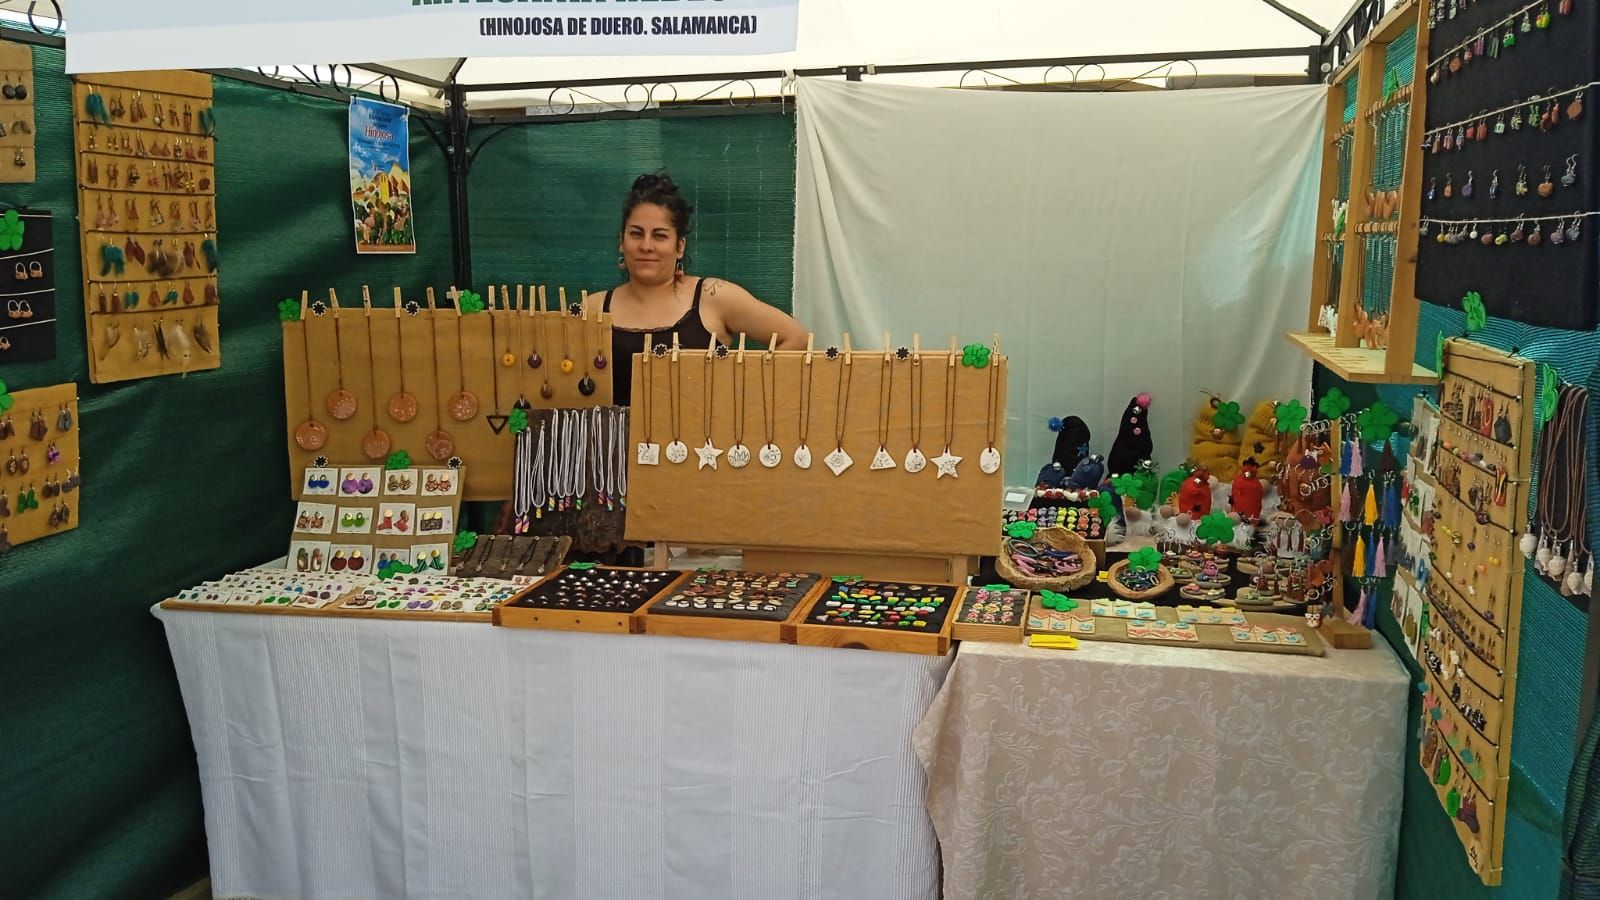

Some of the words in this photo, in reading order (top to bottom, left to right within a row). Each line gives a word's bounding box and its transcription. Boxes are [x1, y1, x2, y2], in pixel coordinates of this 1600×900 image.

[480, 17, 564, 36] (HINOJOSA
[567, 17, 587, 35] DE
[590, 17, 648, 35] DUERO.
[651, 15, 757, 35] SALAMANCA)
